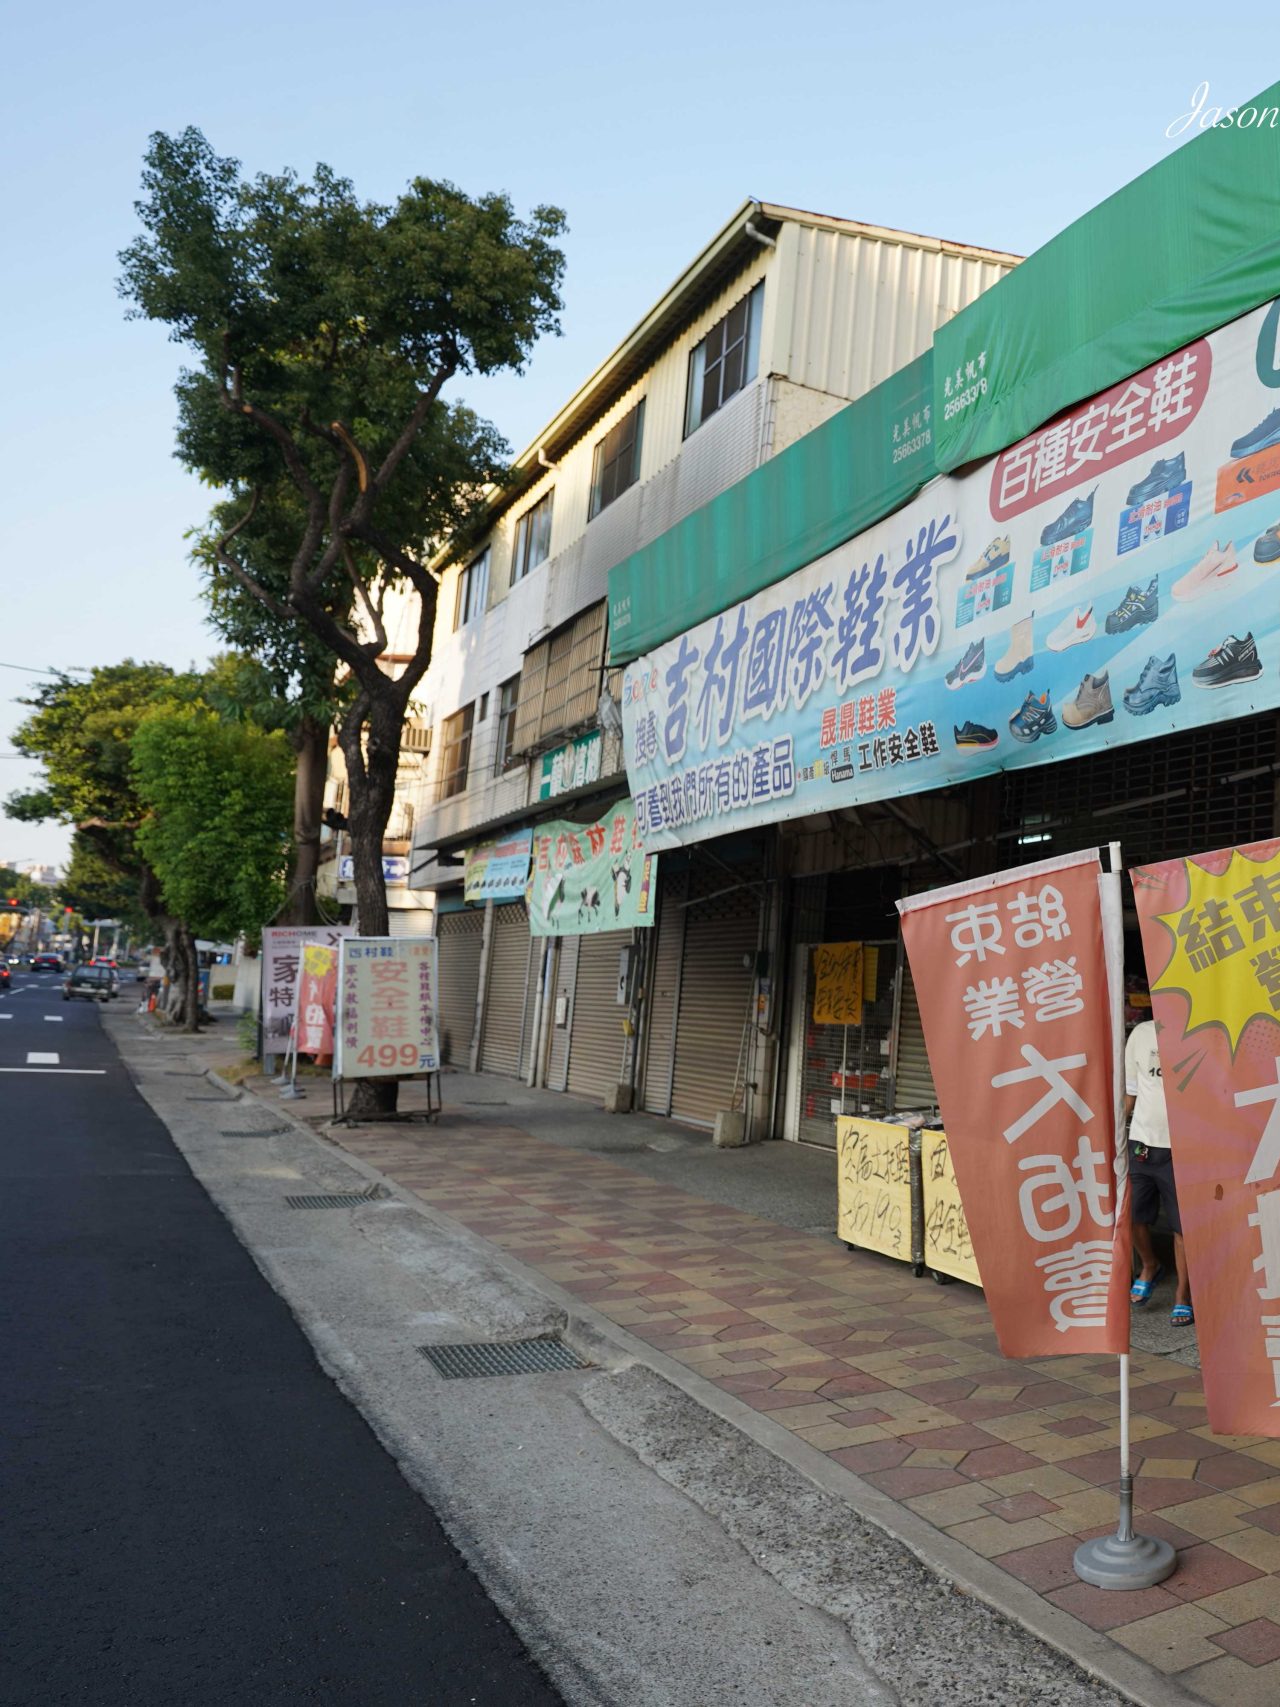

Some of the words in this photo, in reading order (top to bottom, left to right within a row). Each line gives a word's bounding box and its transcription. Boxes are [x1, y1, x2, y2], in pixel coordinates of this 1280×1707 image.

[944, 378, 987, 421] 25663378
[999, 350, 1198, 508] 百種安全鞋
[893, 429, 932, 464] 25663378
[663, 514, 960, 758] 吉村國際鞋業
[820, 687, 896, 747] 晟鼎鞋業
[858, 721, 939, 770] 工作安全鞋
[633, 738, 793, 831] 可看到我們所有的產品
[370, 960, 410, 1040] 安全鞋
[356, 1043, 436, 1068] 499元
